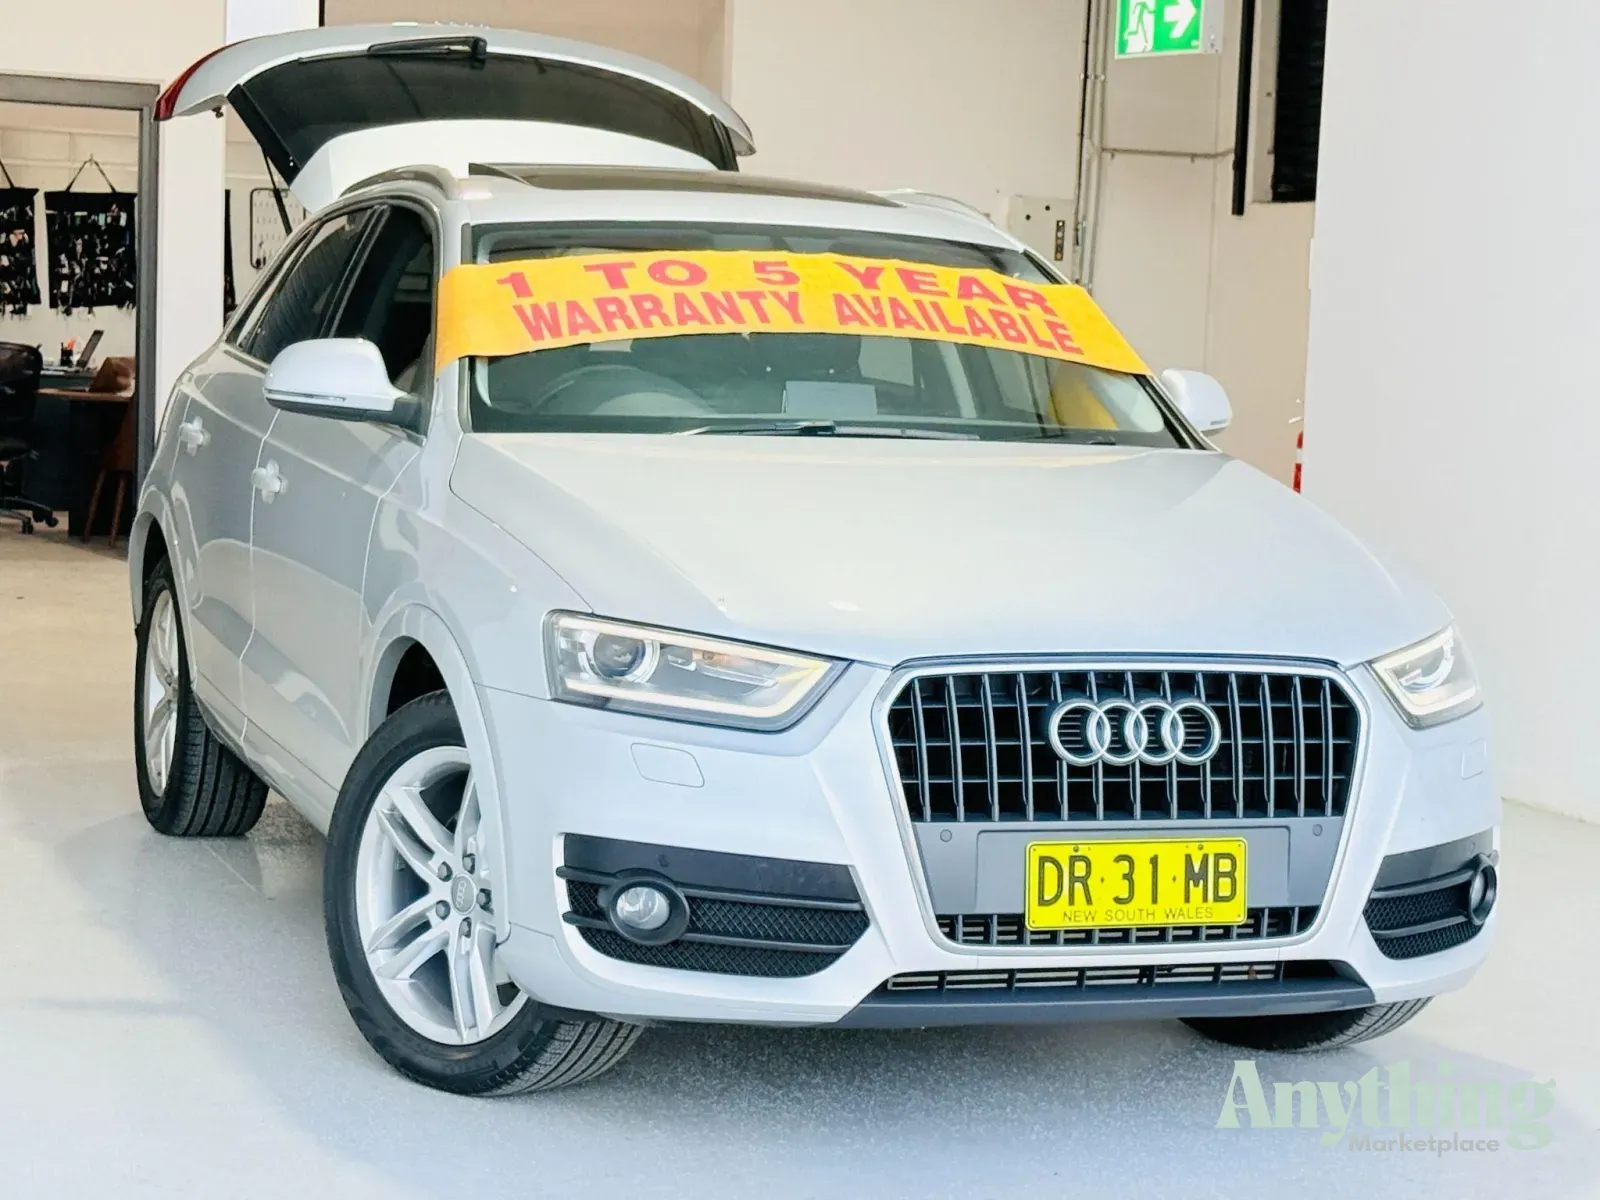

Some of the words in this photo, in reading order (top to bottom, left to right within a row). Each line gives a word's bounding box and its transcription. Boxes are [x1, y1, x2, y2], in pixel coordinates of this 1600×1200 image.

[496, 271, 534, 298] 1
[584, 259, 708, 290] TO
[752, 260, 801, 286] 5
[834, 261, 1060, 318] YEAR
[513, 290, 804, 342] WARRANTY
[832, 293, 1084, 355] AVAILABLE
[1063, 909, 1096, 922] NEW
[1105, 908, 1155, 921] SOUTH
[1165, 906, 1213, 919] WALES
